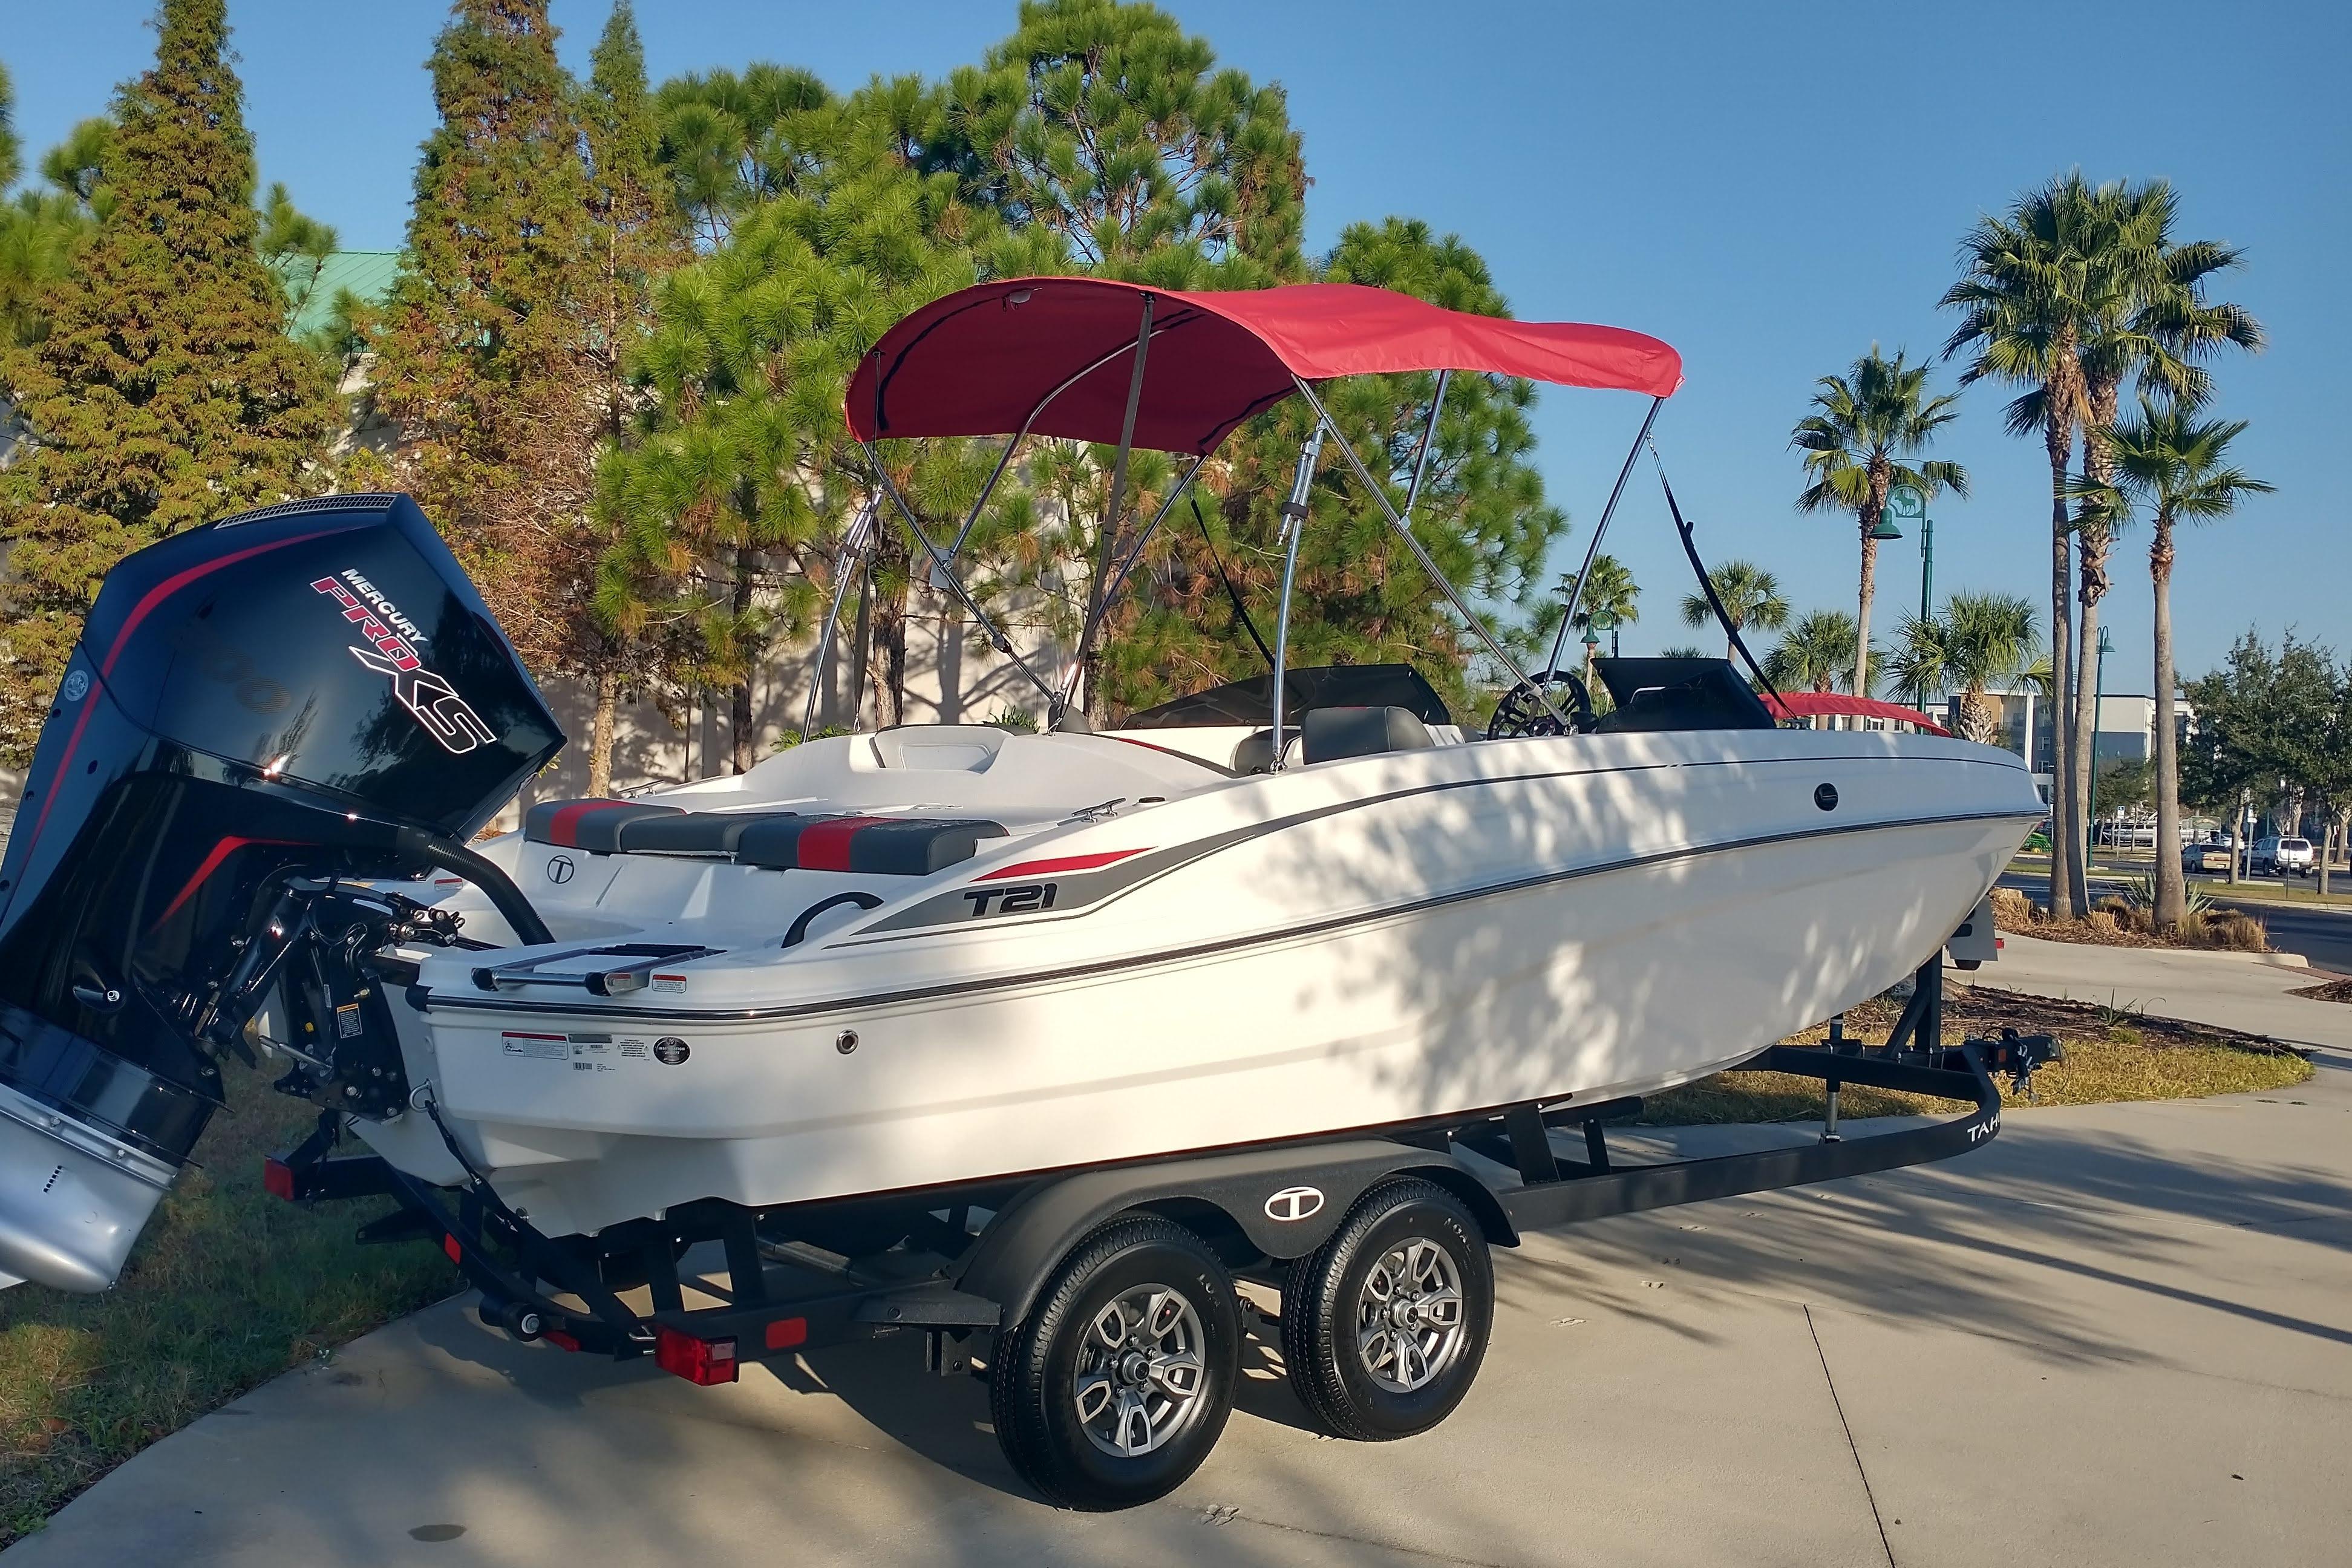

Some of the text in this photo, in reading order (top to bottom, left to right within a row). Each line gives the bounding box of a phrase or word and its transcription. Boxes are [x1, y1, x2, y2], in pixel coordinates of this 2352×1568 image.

[310, 576, 422, 671] PRO
[341, 569, 428, 642] MERCURY
[348, 645, 497, 754] XS
[963, 883, 1058, 916] T21
